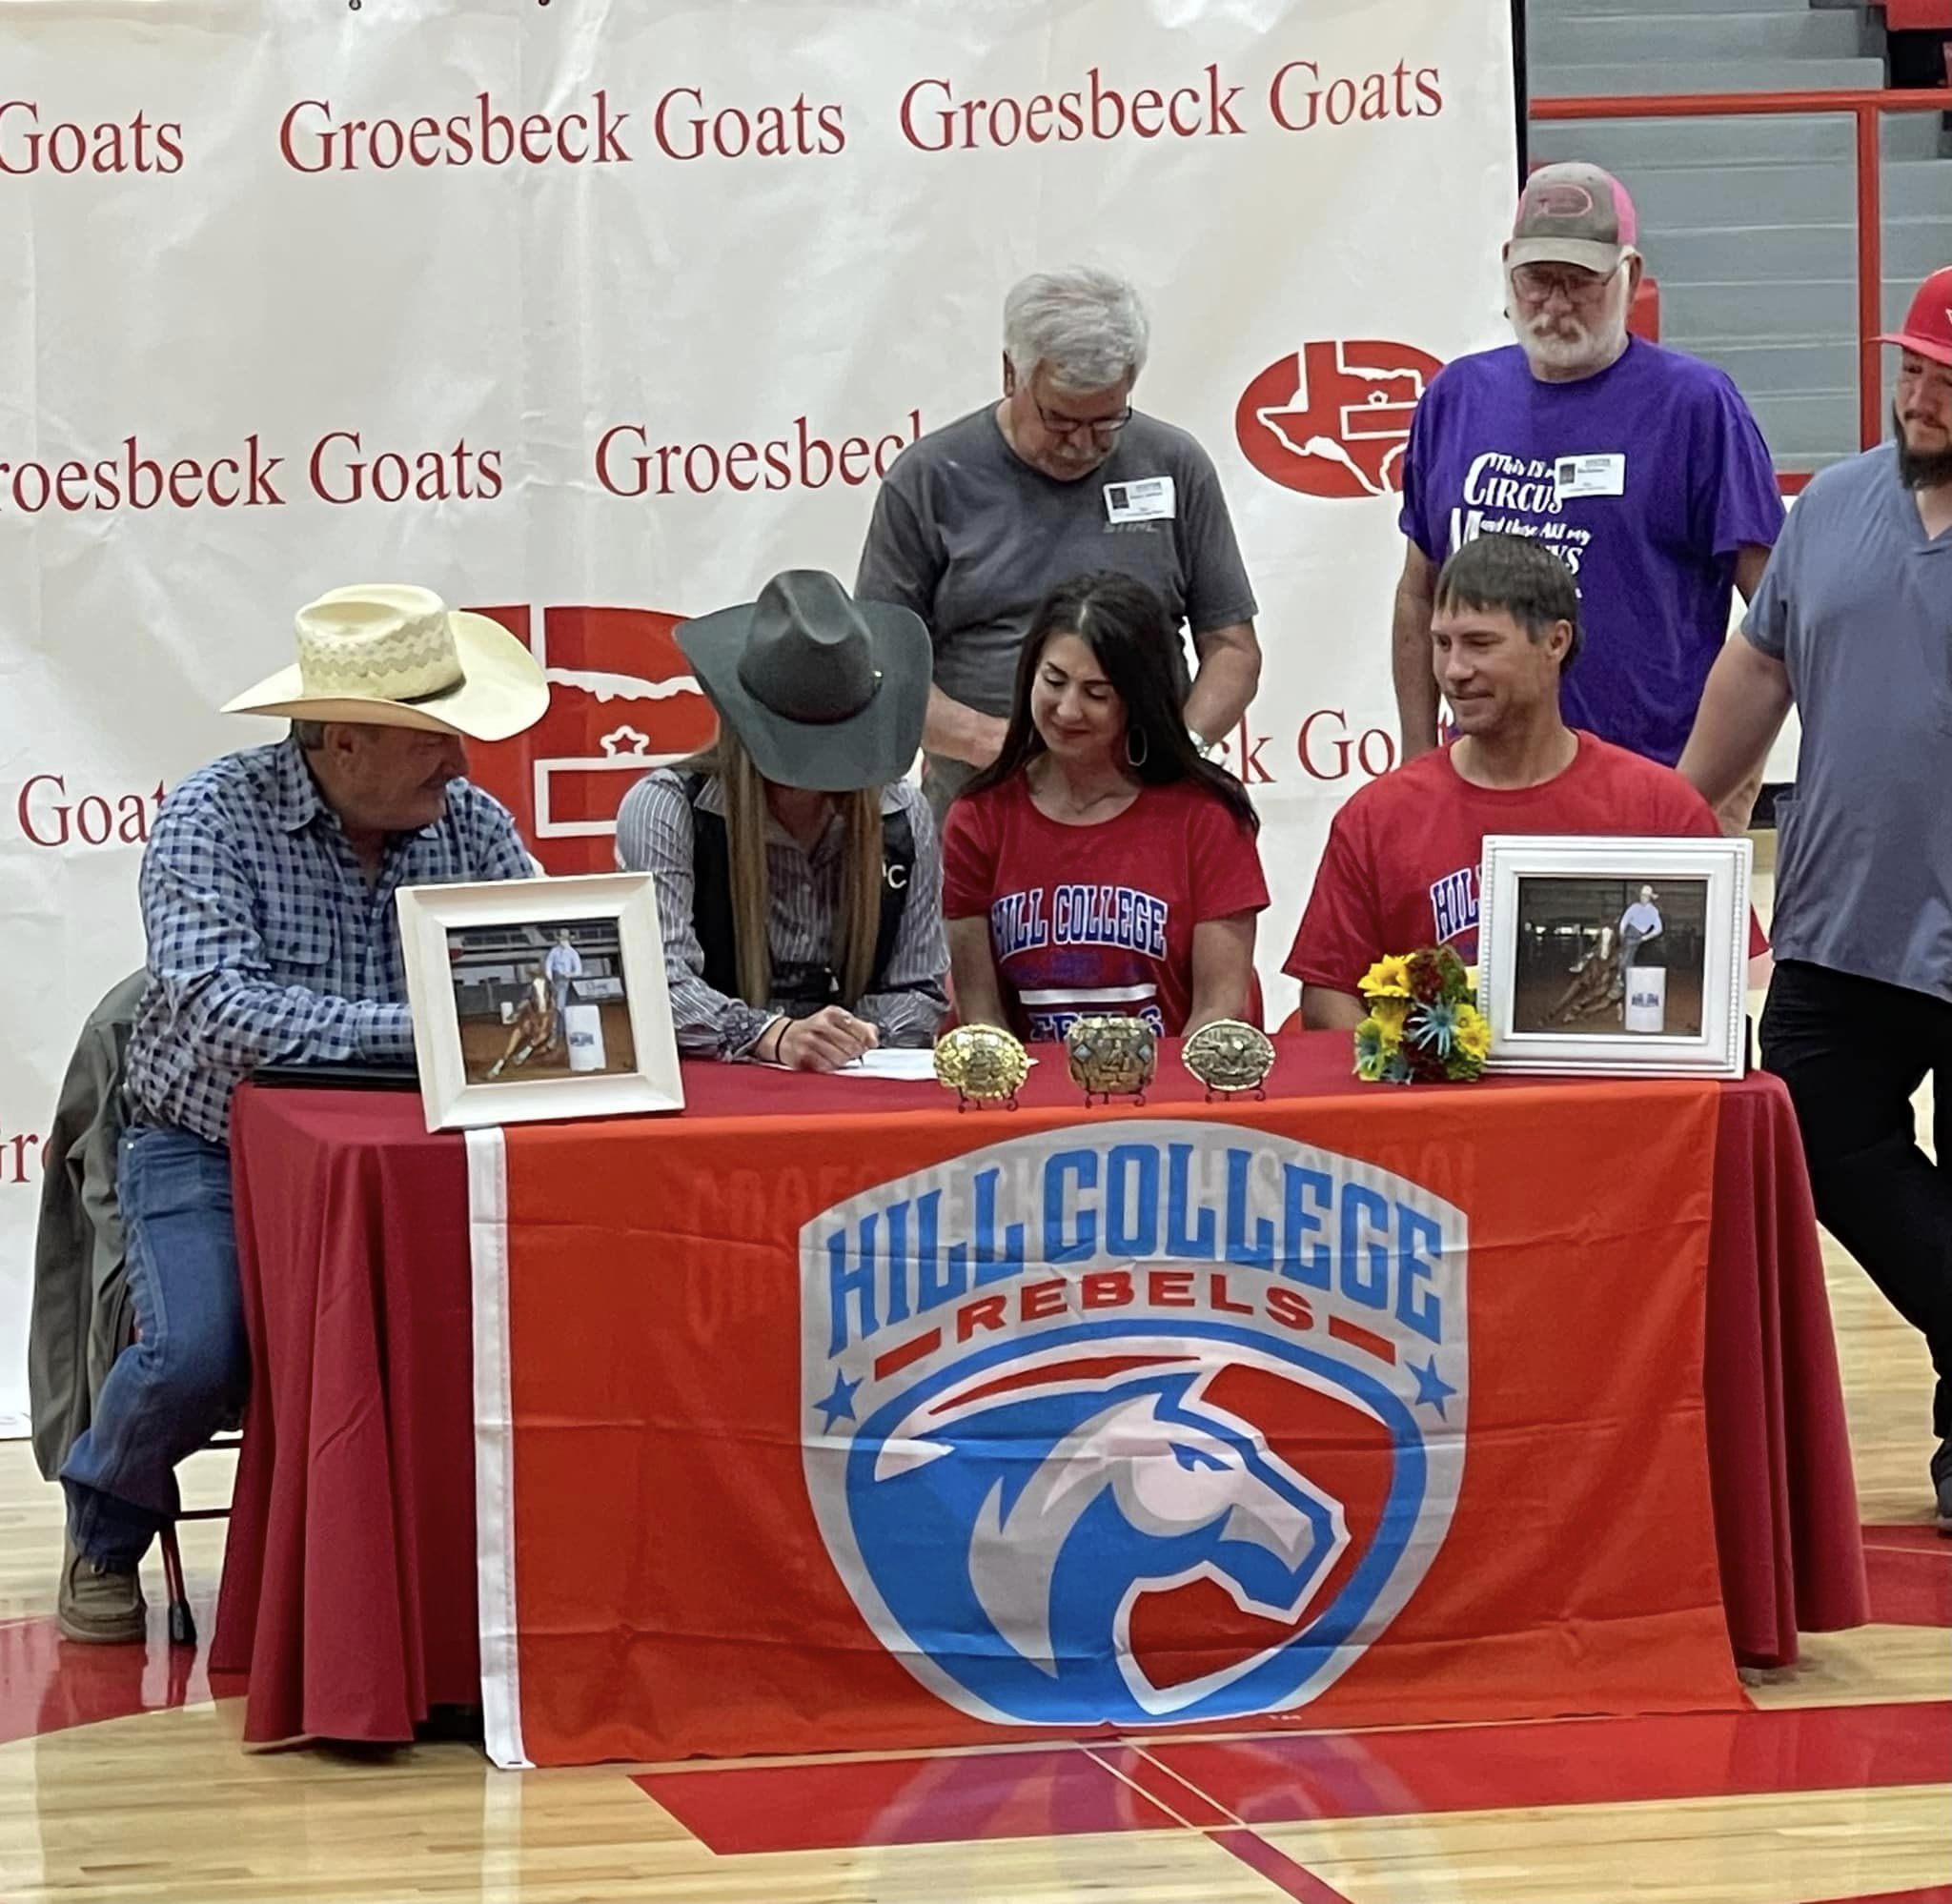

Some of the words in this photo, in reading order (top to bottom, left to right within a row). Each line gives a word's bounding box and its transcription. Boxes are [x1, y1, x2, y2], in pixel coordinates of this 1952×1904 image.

[0, 100, 185, 174] Goats
[279, 91, 633, 173] Groesbeck
[654, 88, 846, 160] Goats
[900, 64, 1246, 152] Groesbeck
[1270, 58, 1443, 132] Goats
[0, 435, 286, 512] oesbeck
[310, 432, 502, 503] Goats
[1464, 453, 1562, 514] CIRCUS
[1052, 885, 1169, 962] COLLEGE
[1431, 865, 1483, 945] HIL
[827, 1167, 1025, 1357] HILL
[1044, 1143, 1443, 1345] COLLEGE
[957, 1270, 1313, 1339] REBELS
